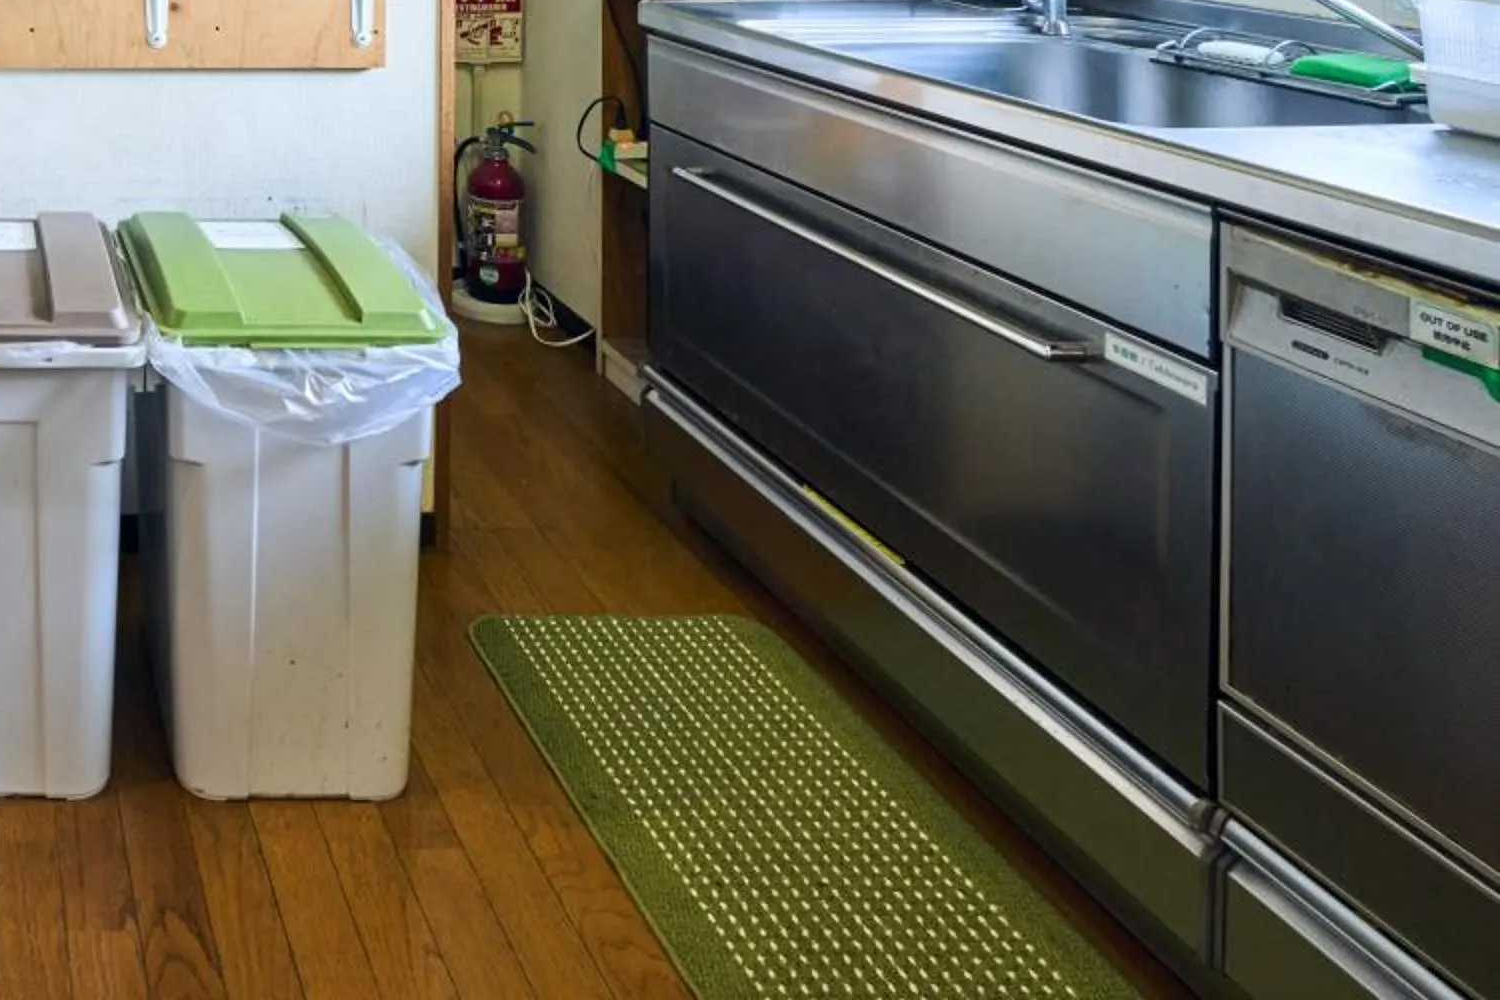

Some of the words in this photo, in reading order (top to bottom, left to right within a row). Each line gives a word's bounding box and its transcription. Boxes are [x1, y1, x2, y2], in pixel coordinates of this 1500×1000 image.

[1420, 311, 1444, 328] OUT
[1446, 320, 1461, 332] OF
[1463, 327, 1489, 343] USE
